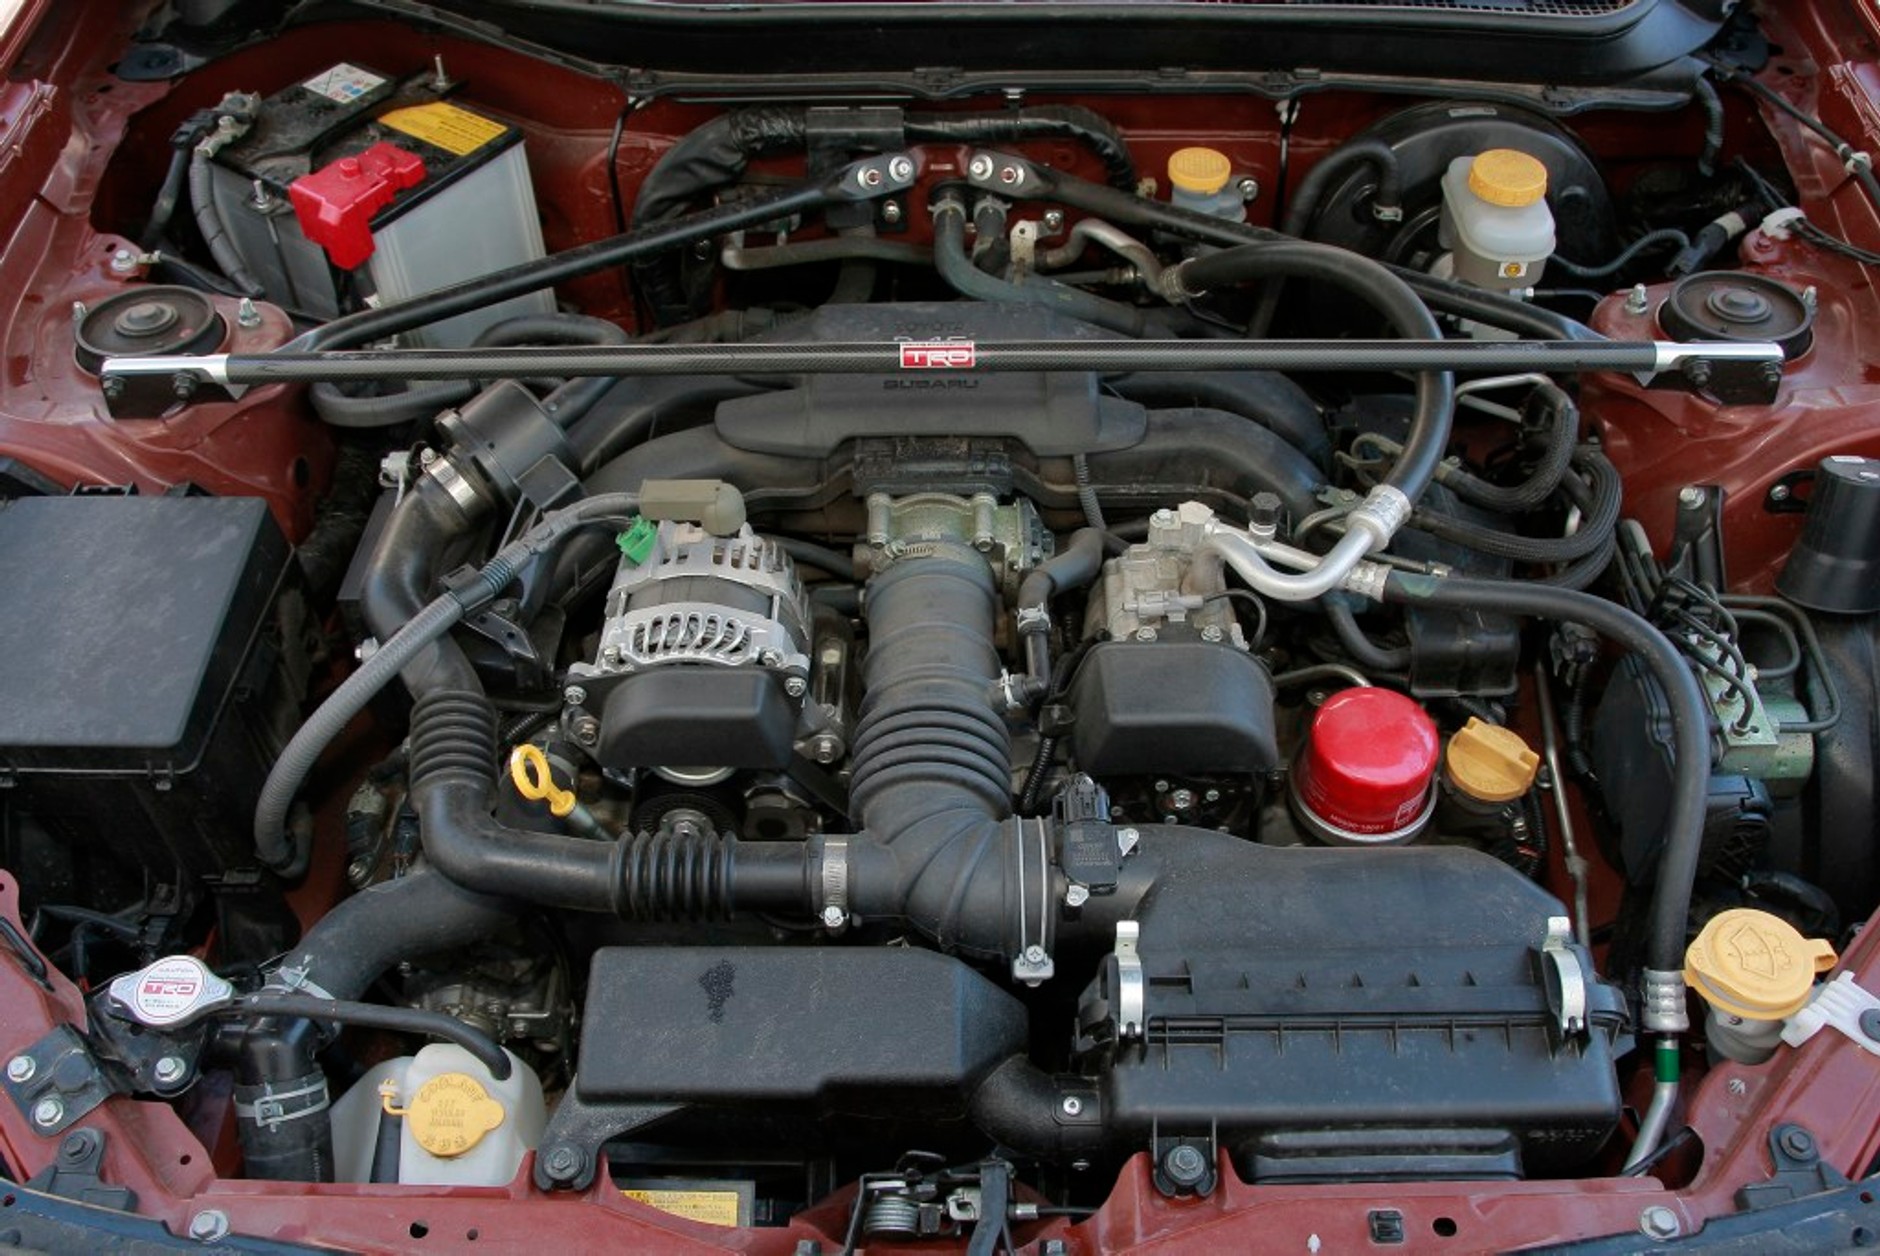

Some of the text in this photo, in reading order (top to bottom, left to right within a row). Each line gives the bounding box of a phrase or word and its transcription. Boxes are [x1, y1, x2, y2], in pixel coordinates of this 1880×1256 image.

[894, 321, 964, 332] TOYOTA
[904, 350, 969, 367] TRD
[883, 380, 979, 390] SUBARU
